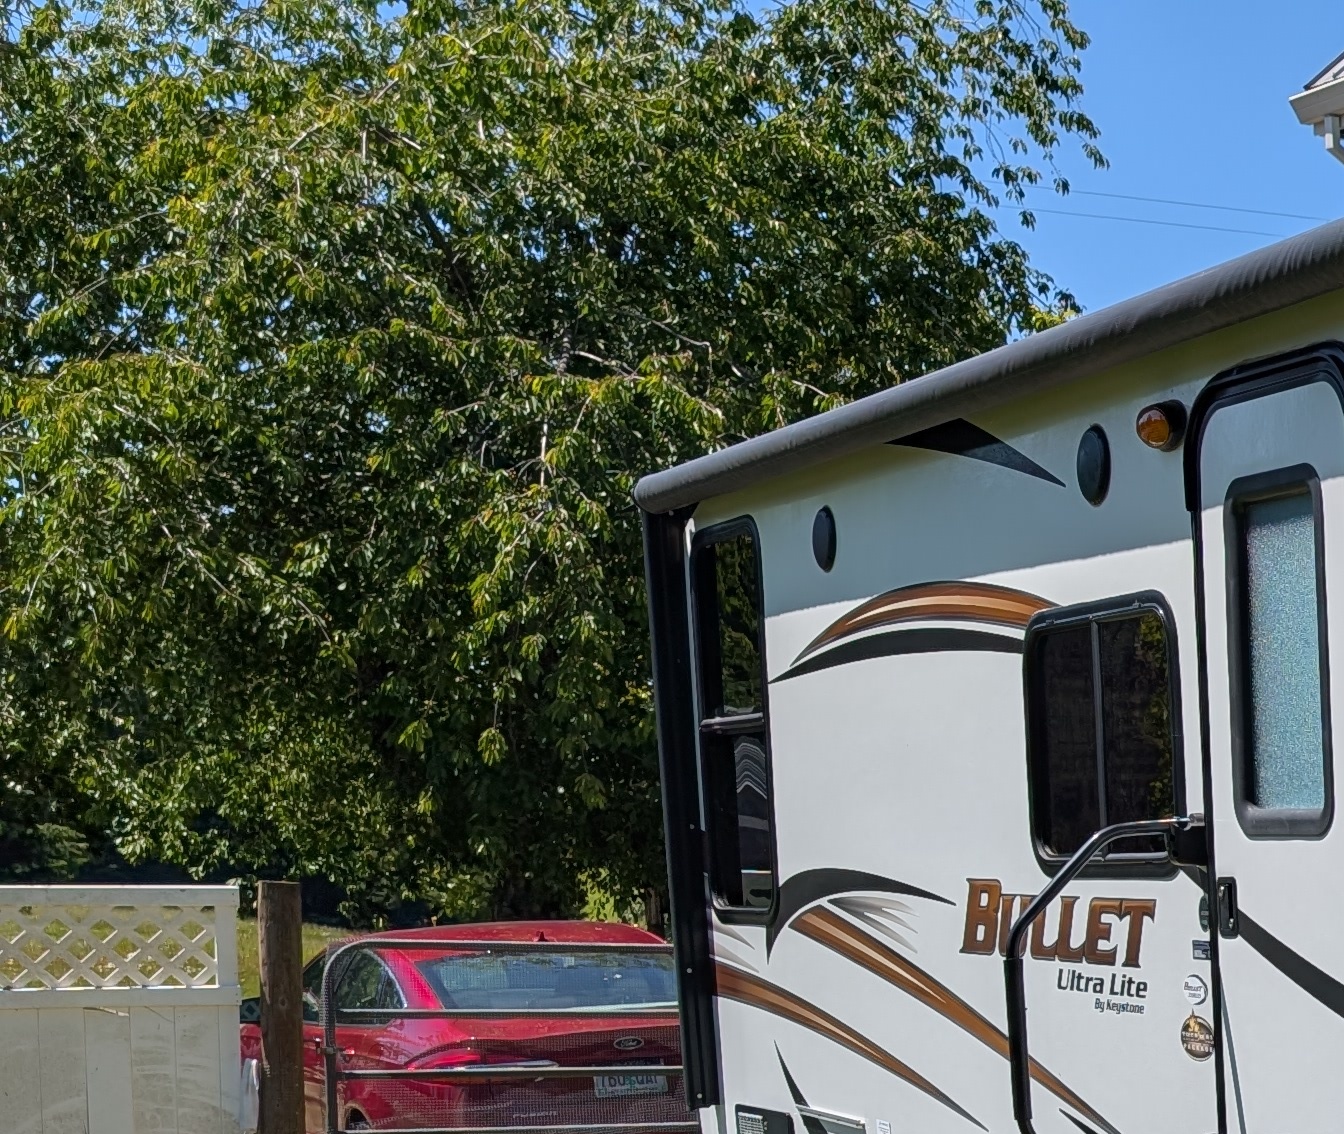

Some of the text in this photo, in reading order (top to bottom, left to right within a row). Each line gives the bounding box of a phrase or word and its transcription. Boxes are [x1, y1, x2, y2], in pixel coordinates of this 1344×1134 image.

[1057, 968, 1148, 998] Ultra Lite
[1094, 998, 1145, 1014] By Keystone
